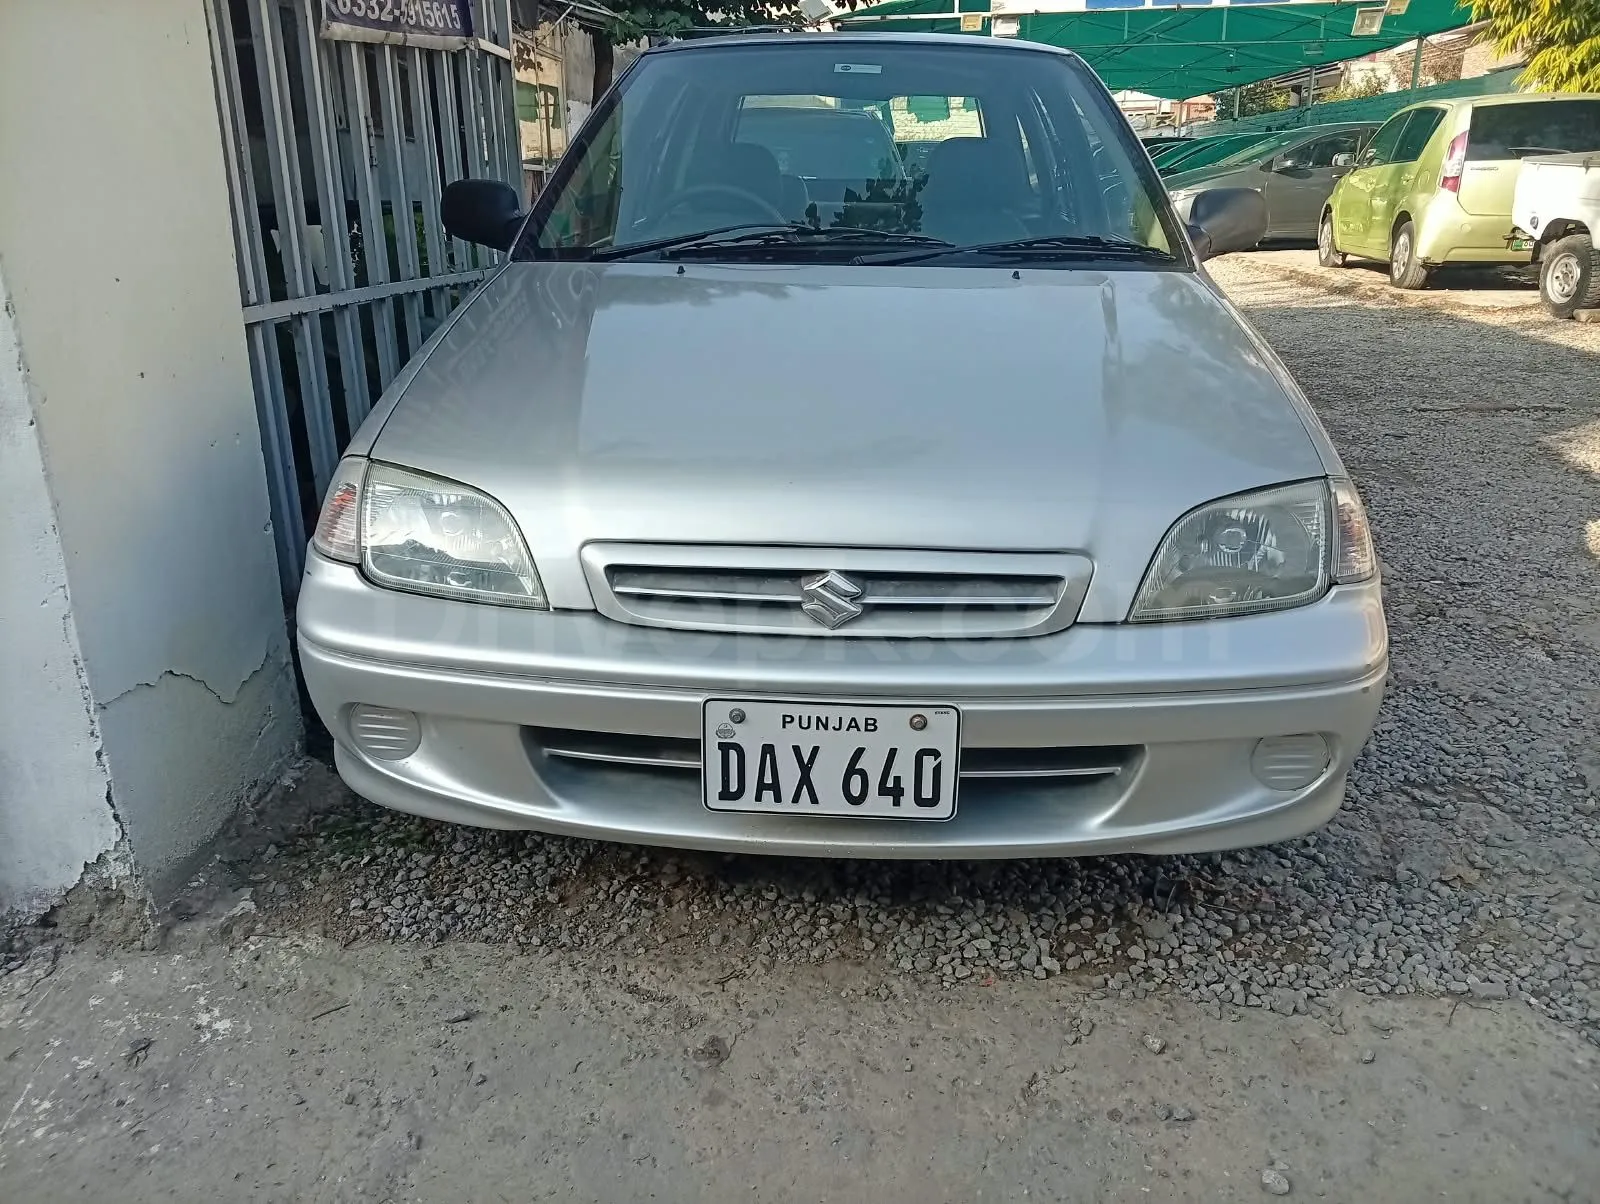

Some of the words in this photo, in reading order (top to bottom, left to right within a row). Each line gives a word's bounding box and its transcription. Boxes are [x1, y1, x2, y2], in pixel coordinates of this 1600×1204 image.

[781, 714, 879, 733] PUNJAB
[717, 741, 820, 805] DAX
[841, 746, 942, 808] 640
